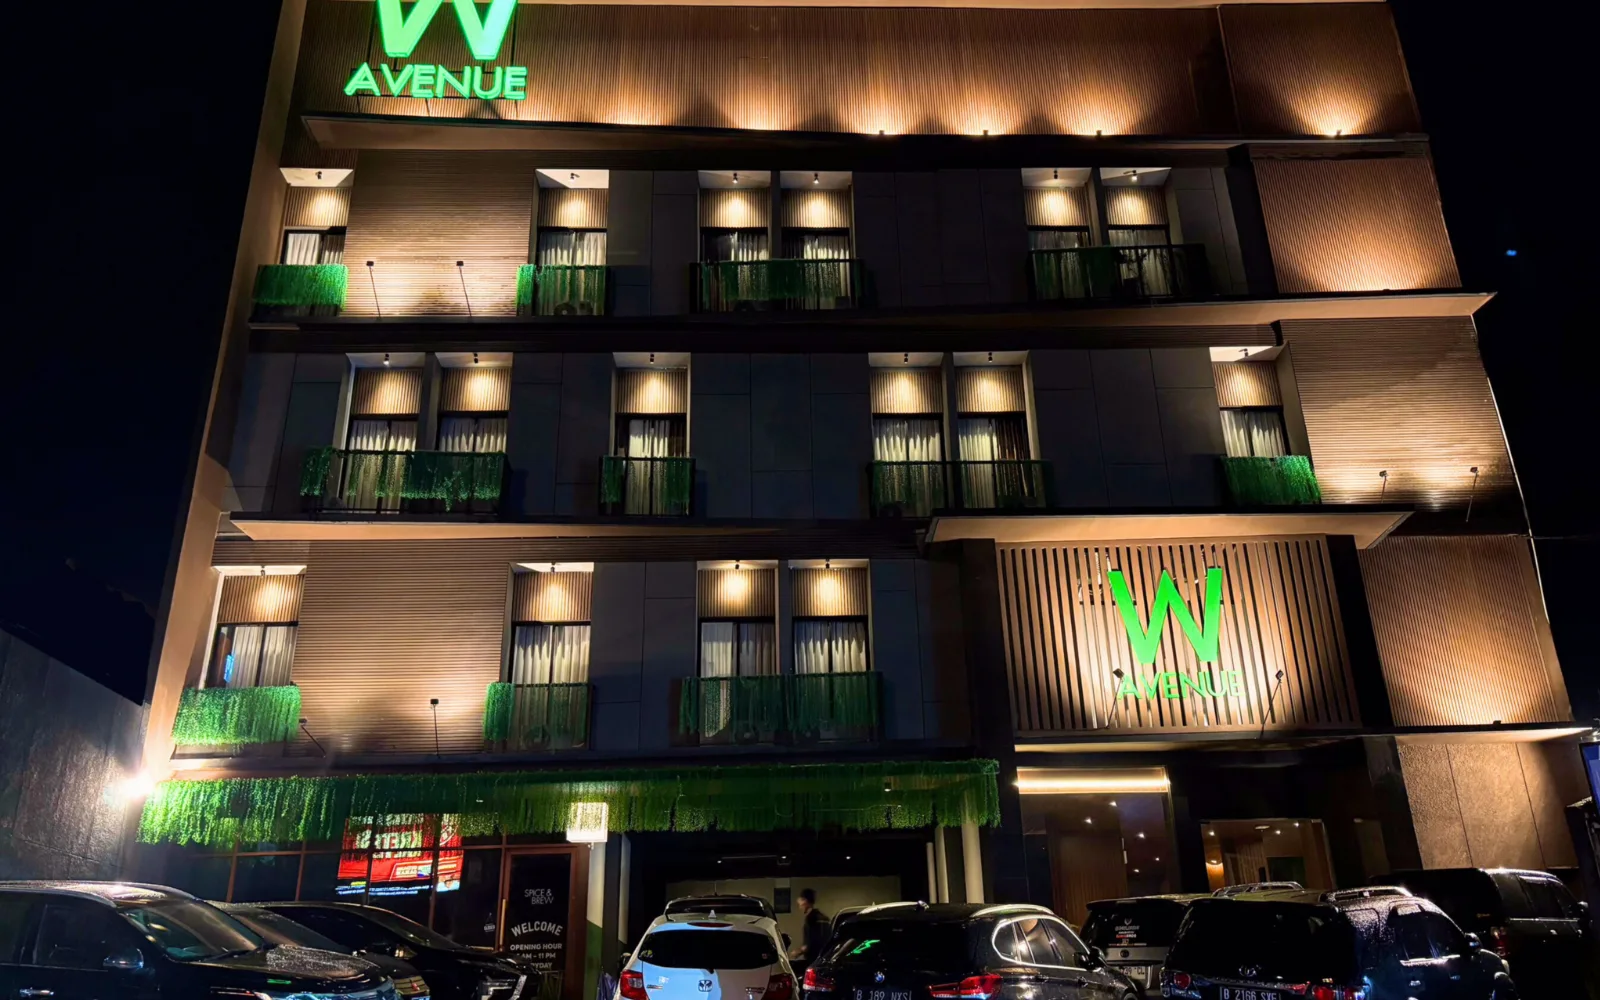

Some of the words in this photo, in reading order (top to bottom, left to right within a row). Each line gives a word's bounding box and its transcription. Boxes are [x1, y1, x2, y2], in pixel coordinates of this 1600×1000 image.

[344, 62, 528, 101] AVENUE
[1107, 567, 1224, 664] W
[1117, 670, 1245, 700] AVENUE
[524, 888, 545, 897] SPICE
[545, 888, 552, 897] &
[531, 896, 554, 905] BREW
[510, 920, 564, 937] WELCOME
[509, 943, 542, 951] OPENING
[542, 943, 563, 951] HOUR
[856, 989, 863, 1000] B
[868, 990, 886, 1000] 189
[1223, 988, 1230, 1000] B
[1234, 989, 1257, 1000] 2166
